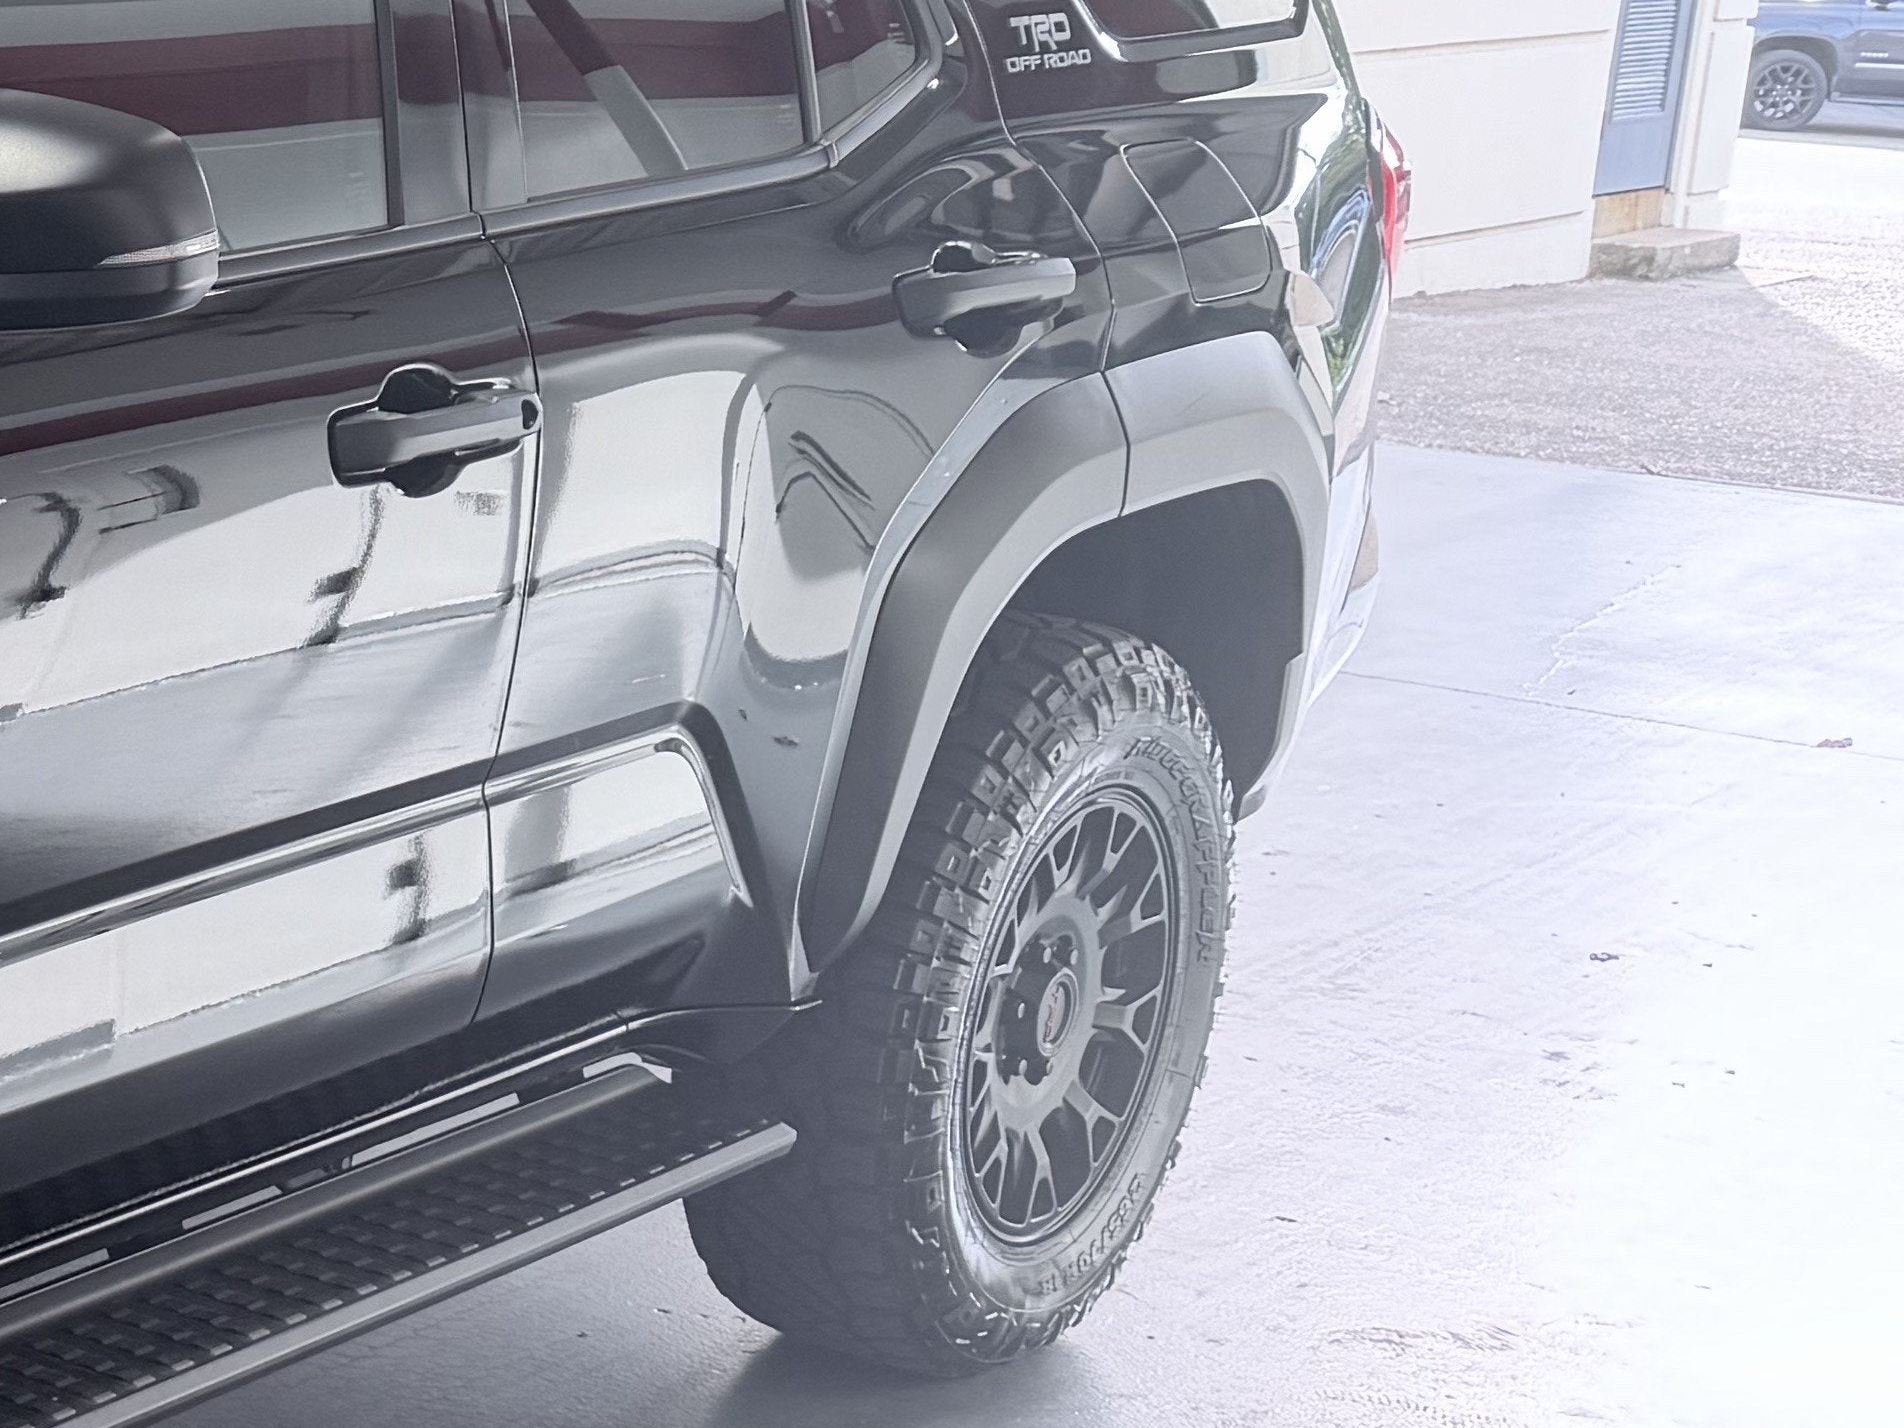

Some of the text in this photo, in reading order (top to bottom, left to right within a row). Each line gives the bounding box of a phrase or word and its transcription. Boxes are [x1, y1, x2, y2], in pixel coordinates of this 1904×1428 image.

[1009, 12, 1072, 52] TRD
[1005, 48, 1092, 73] OFF ROAD
